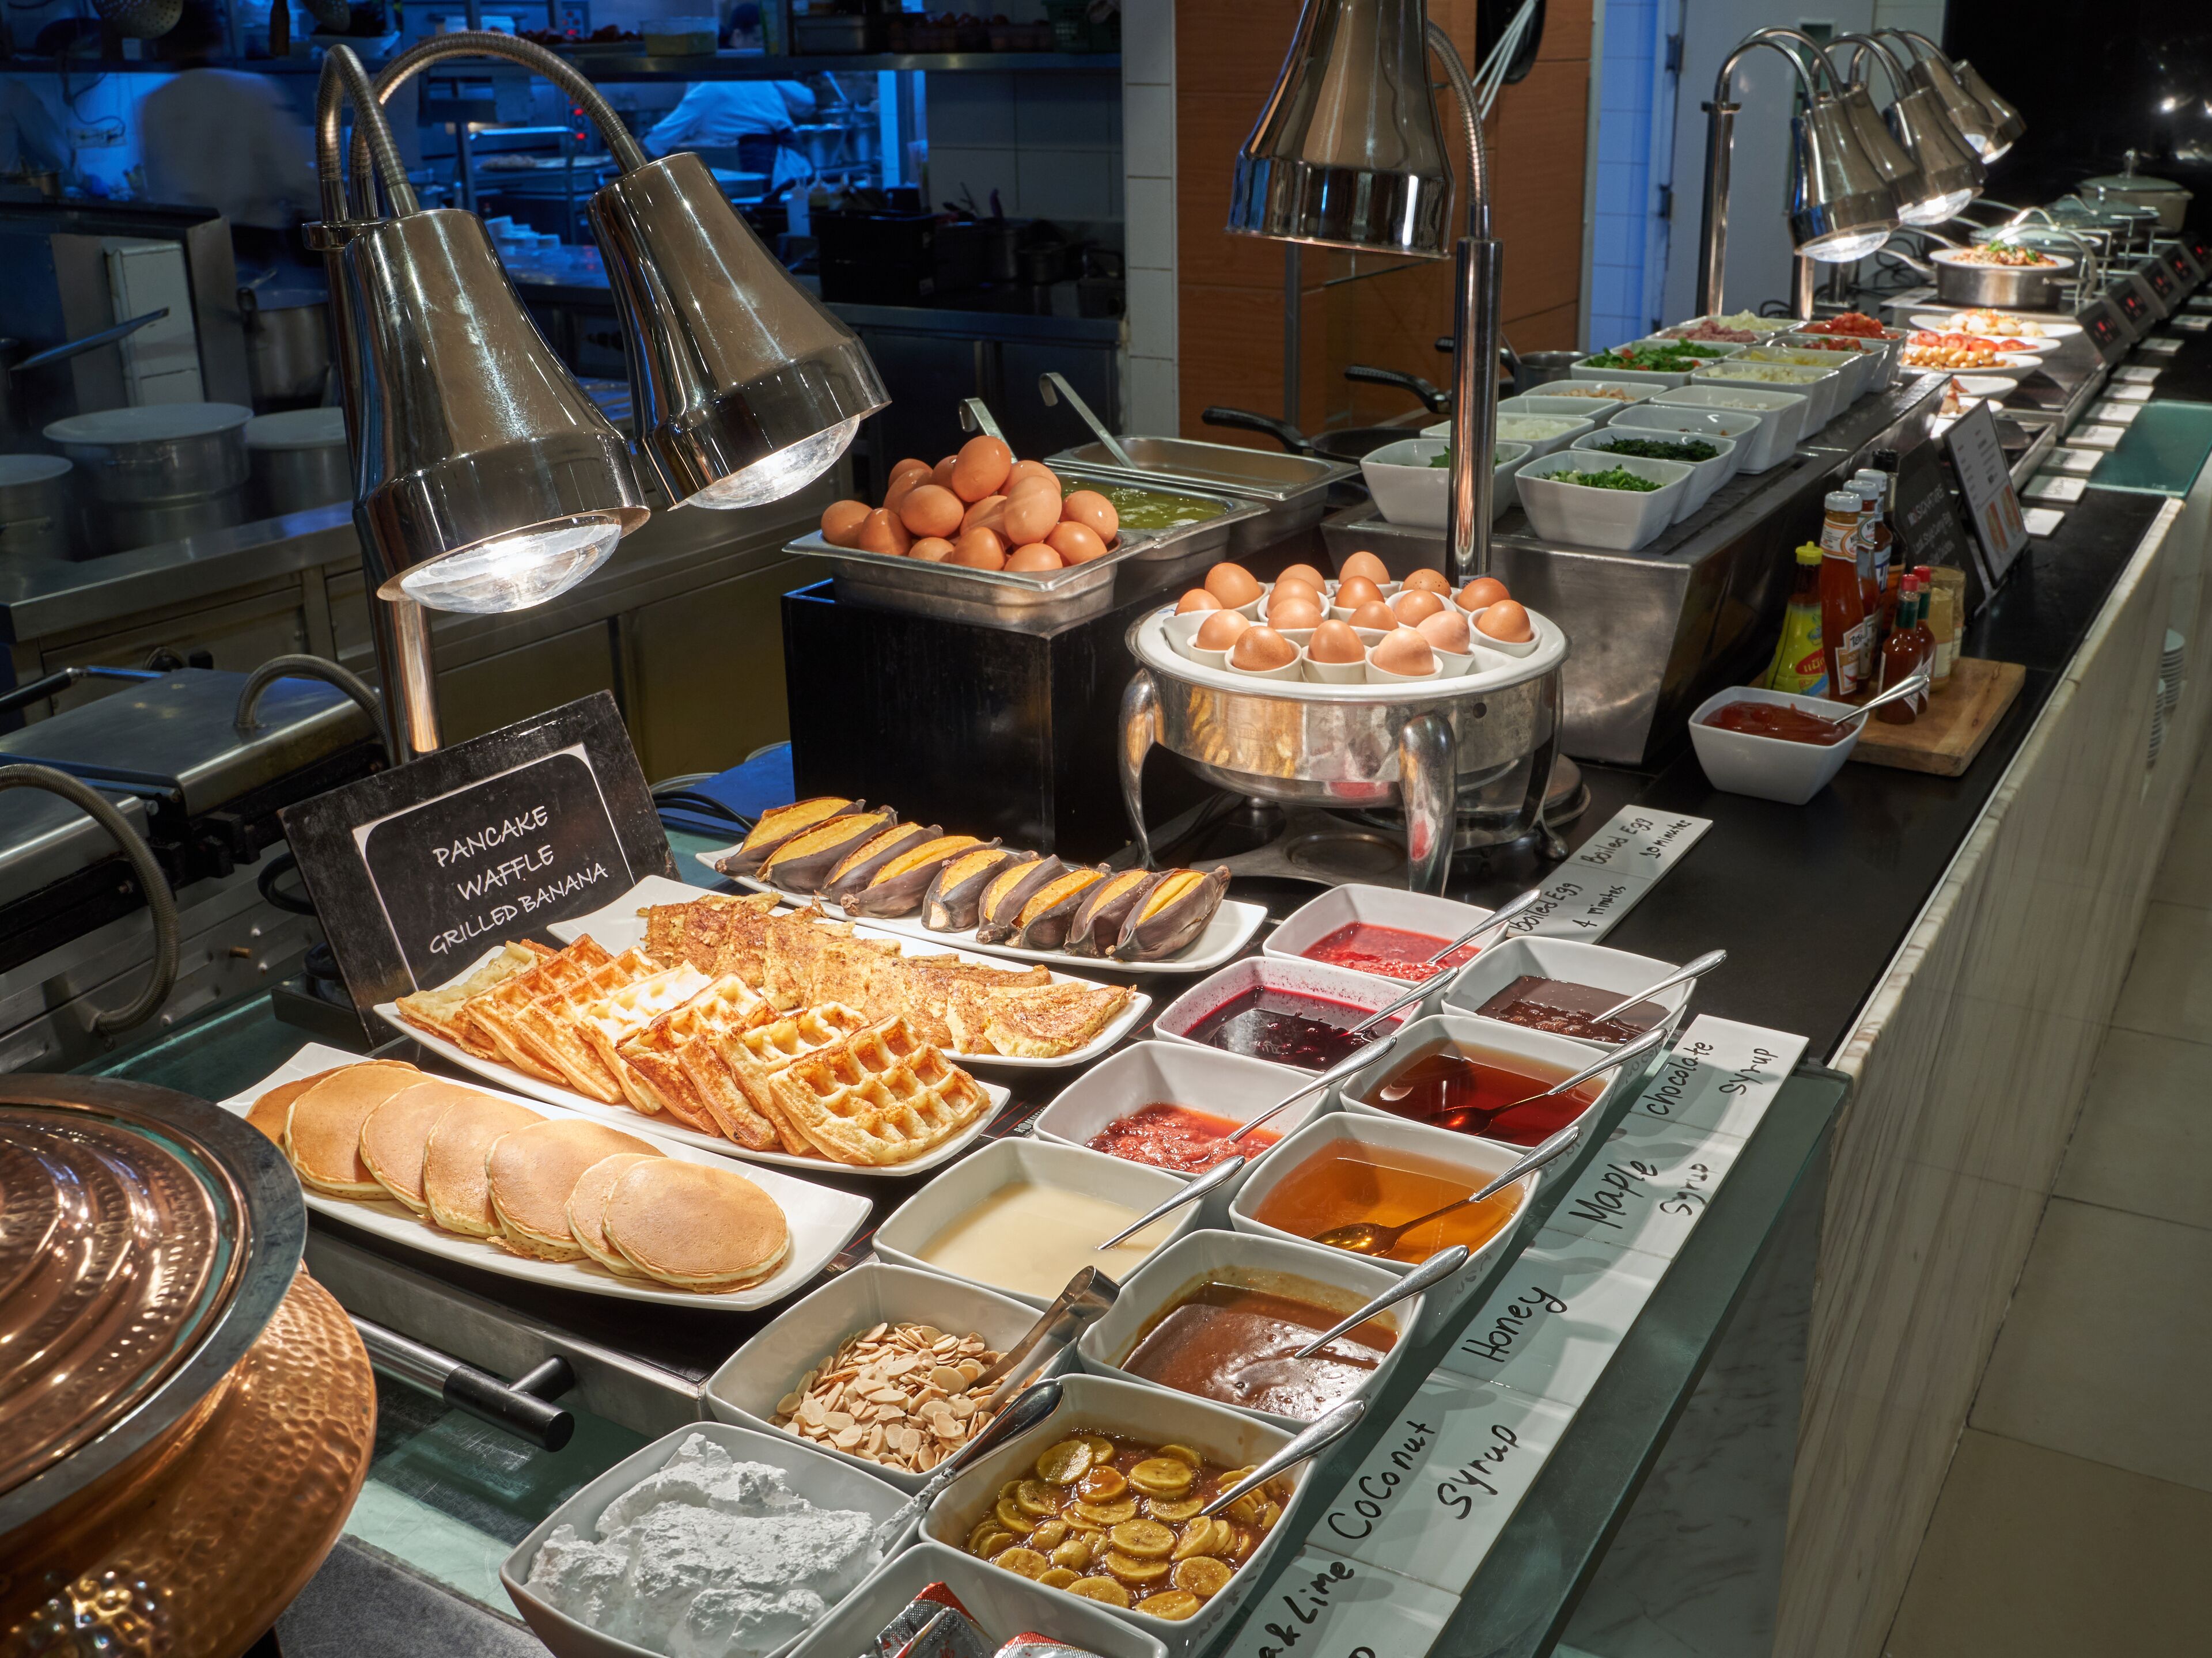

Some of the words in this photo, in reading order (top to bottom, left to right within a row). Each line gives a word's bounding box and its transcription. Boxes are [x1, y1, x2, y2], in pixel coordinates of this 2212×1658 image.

[432, 806, 548, 867] PANCAKE
[1618, 818, 1654, 834] Egg
[1639, 847, 1661, 859] 10
[1654, 819, 1692, 847] minutes
[457, 845, 554, 900] WAFFLE
[1545, 883, 1584, 901] Egg
[430, 905, 517, 954] GRILLED
[518, 863, 608, 912] BANANA
[1573, 919, 1598, 928] 4
[1587, 885, 1627, 915] minutes
[1719, 1048, 1779, 1096] Syrup
[1568, 1160, 1658, 1229] Maple
[1461, 1287, 1568, 1363] Honey
[1438, 1424, 1520, 1520] Syrup
[1283, 1561, 1355, 1624] Lime
